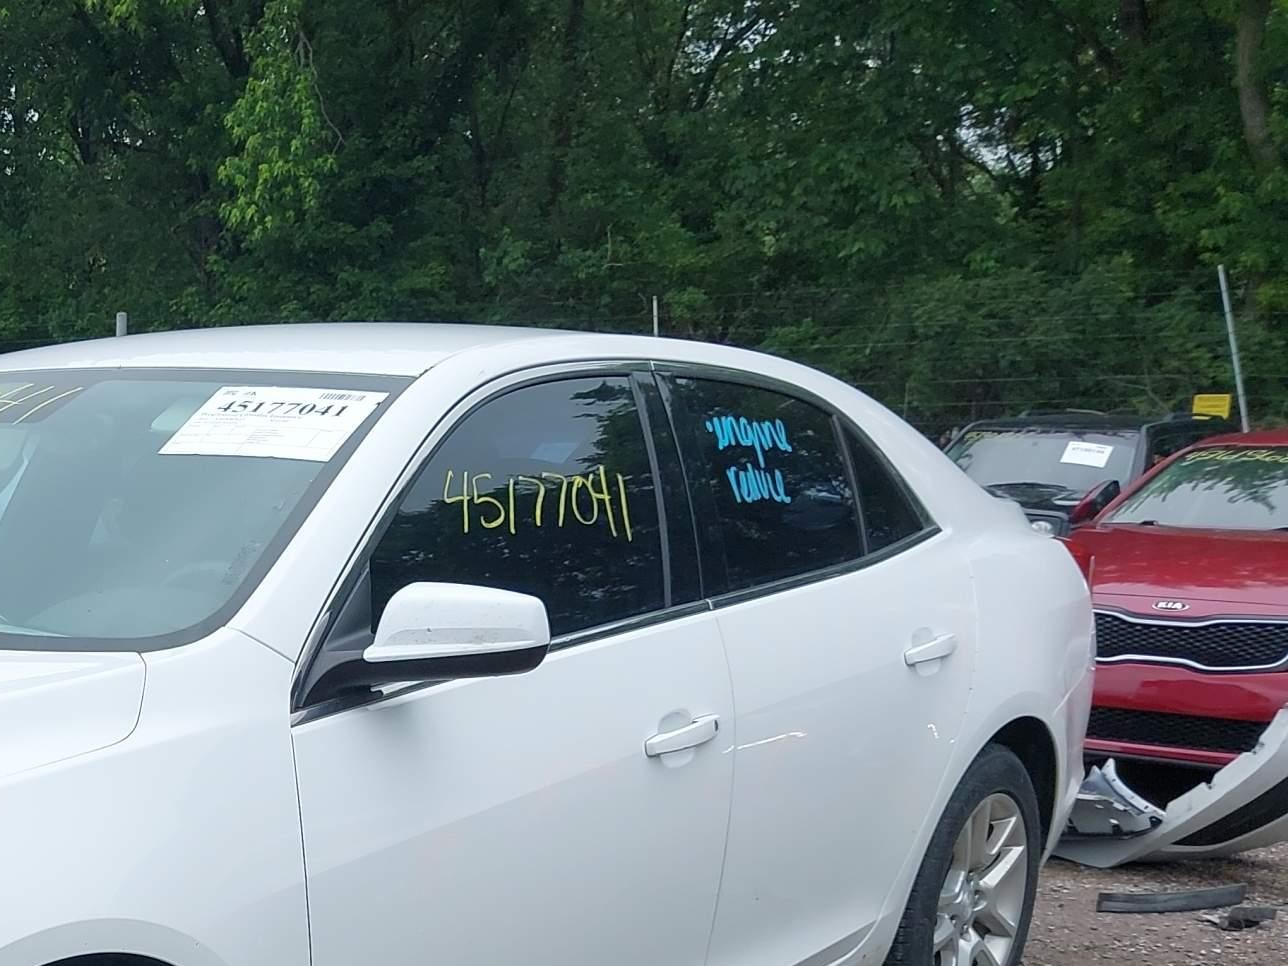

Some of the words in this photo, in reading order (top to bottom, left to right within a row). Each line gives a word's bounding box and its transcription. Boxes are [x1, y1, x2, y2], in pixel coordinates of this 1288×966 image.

[217, 399, 350, 417] 45177041
[443, 464, 633, 542] 45177041
[1156, 601, 1183, 610] KIA
